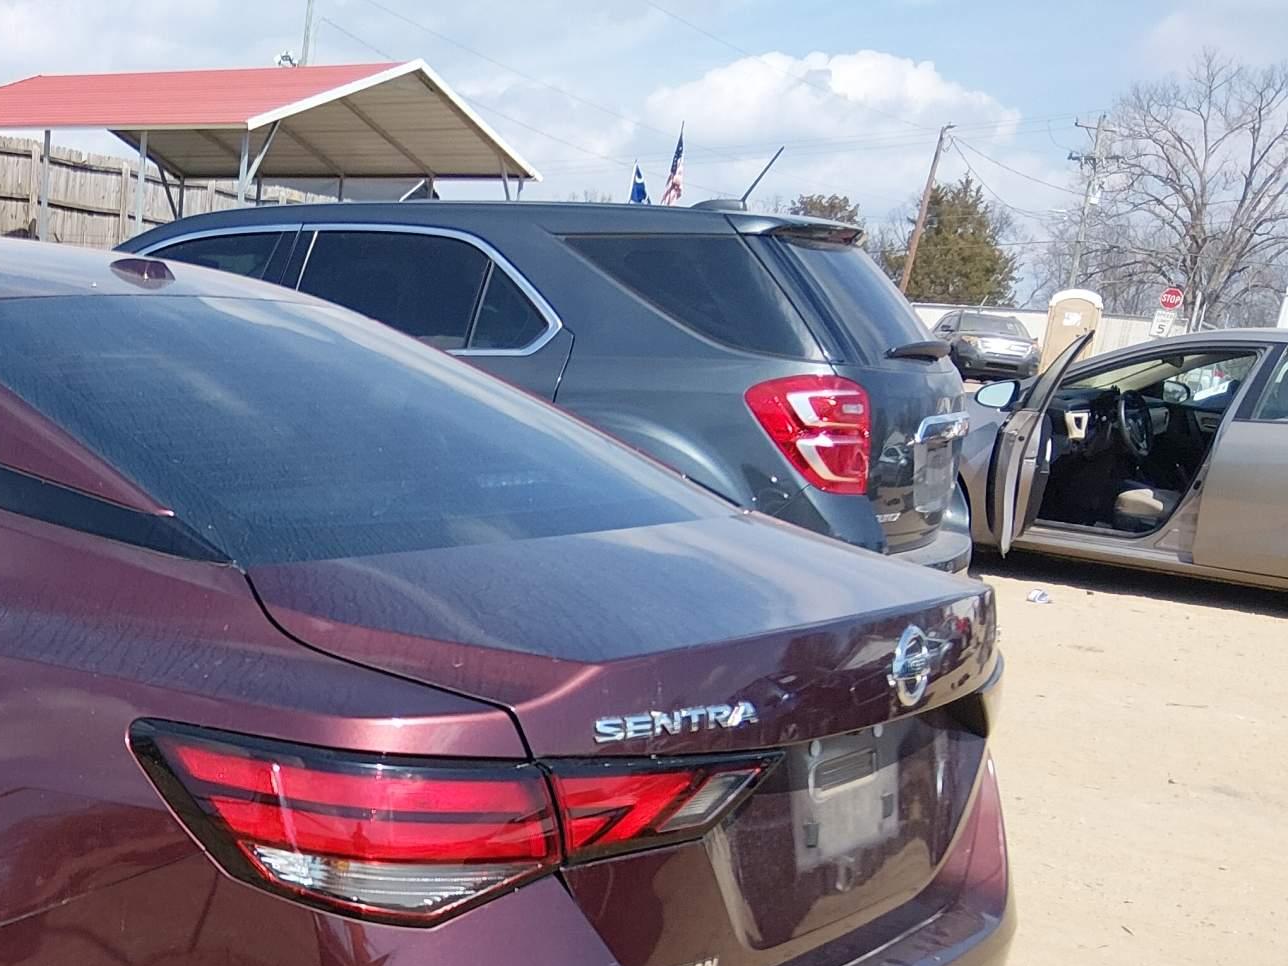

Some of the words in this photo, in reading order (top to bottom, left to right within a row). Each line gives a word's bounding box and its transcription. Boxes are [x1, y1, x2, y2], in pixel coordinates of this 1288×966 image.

[1161, 293, 1181, 304] STOP
[1156, 324, 1166, 334] 5
[594, 701, 759, 743] SENTRA
